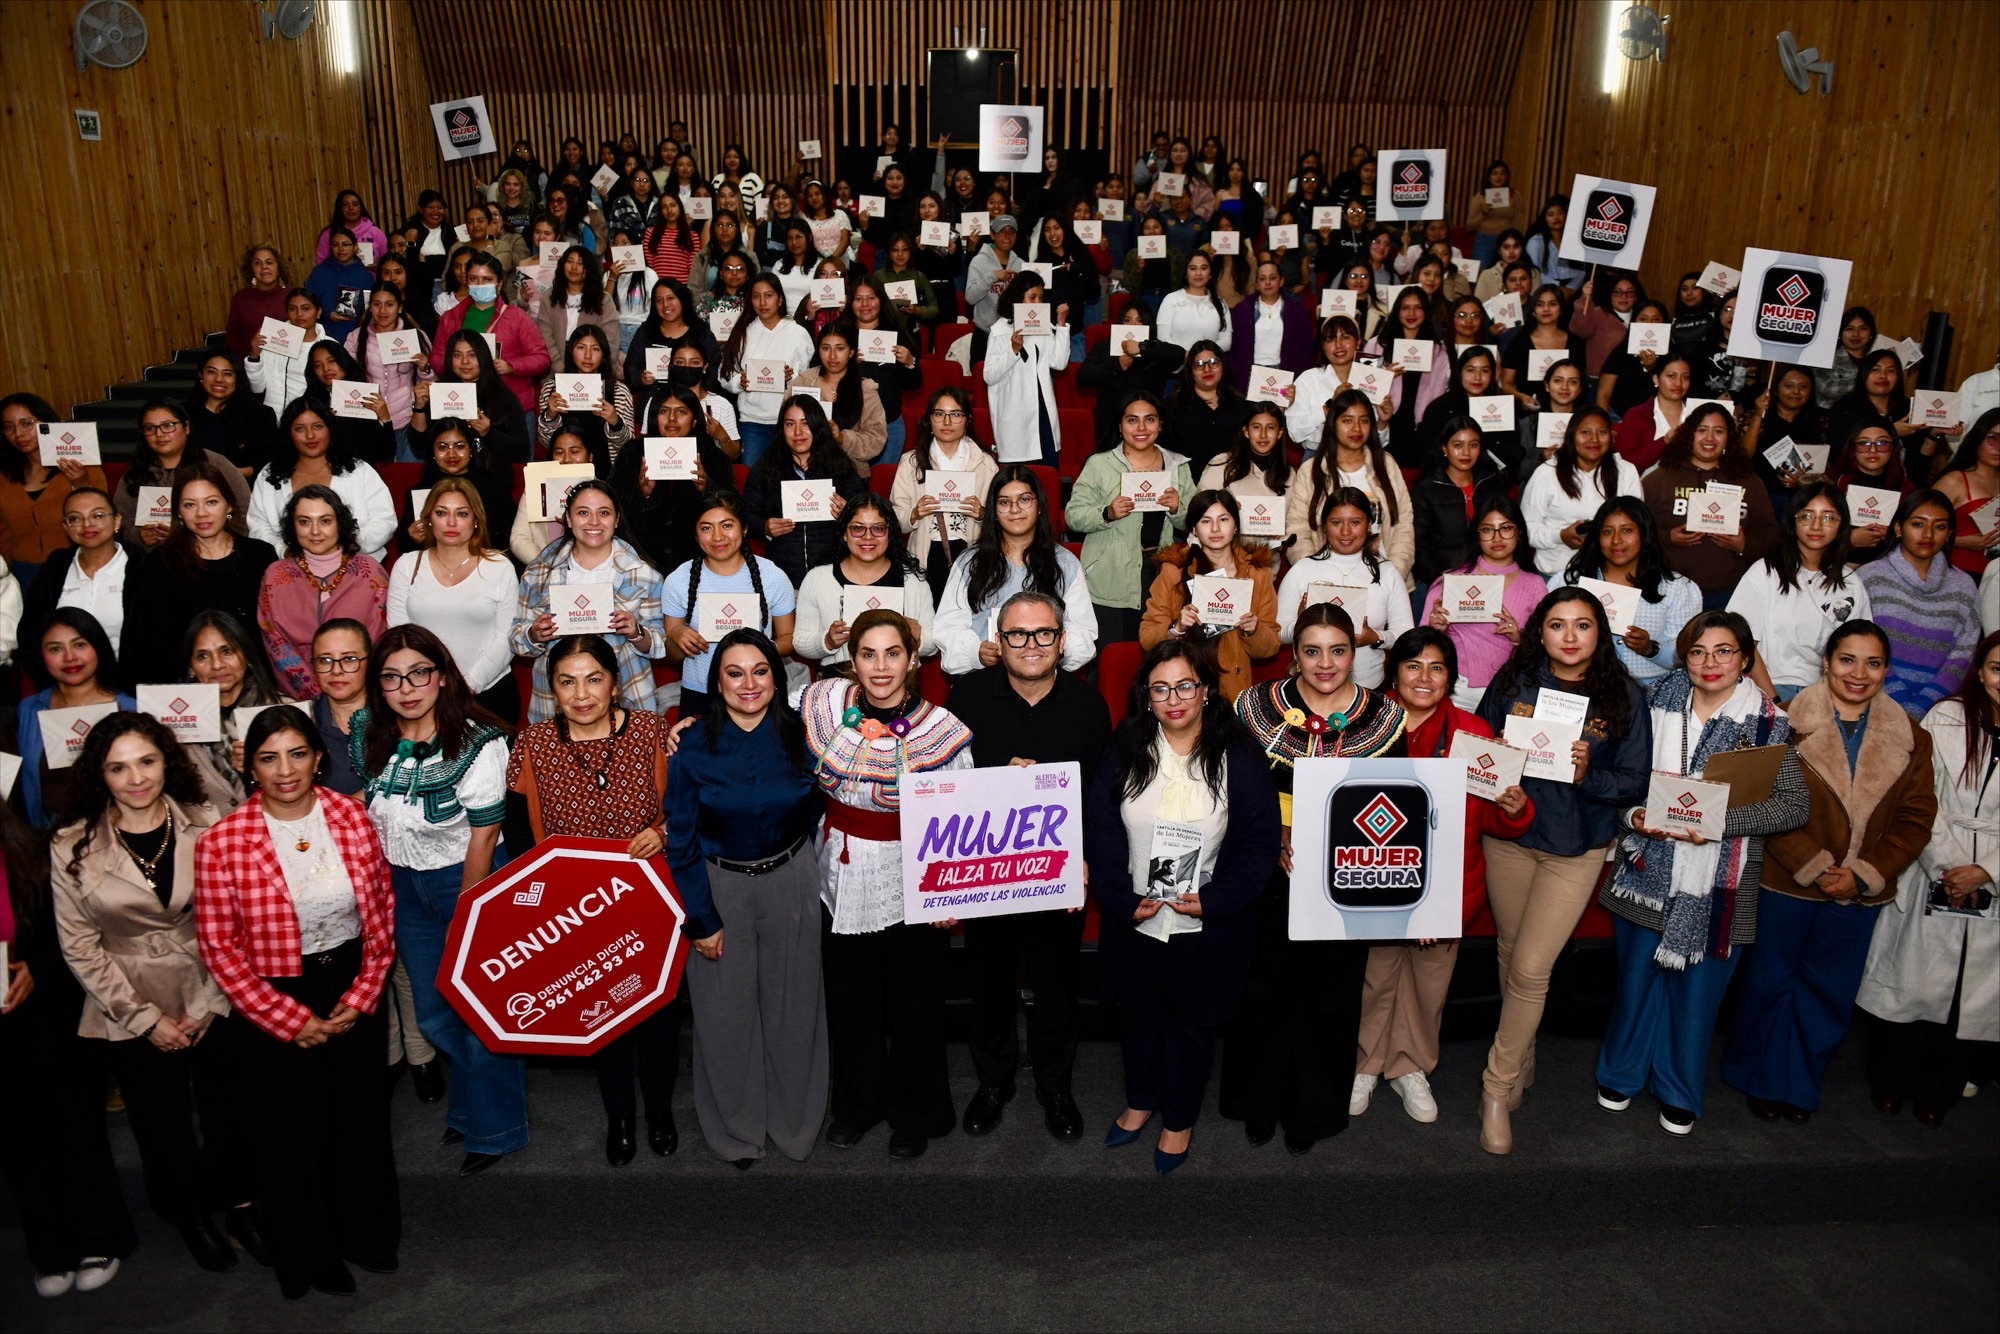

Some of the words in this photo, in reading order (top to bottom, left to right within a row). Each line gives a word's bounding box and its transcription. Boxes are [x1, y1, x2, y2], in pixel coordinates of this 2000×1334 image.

[451, 126, 477, 136] MUJER
[453, 132, 479, 142] SEGURA
[1586, 220, 1626, 234] MUJER
[1584, 230, 1623, 243] SEGURA
[1762, 304, 1815, 322] MUJER
[1761, 318, 1812, 334] SEGURA
[1528, 749, 1555, 760] UJER
[1467, 766, 1498, 781] MUJER
[1667, 813, 1702, 824] SEGURA
[1668, 806, 1703, 818] MUJER
[917, 804, 1068, 862] MUJER
[1176, 832, 1201, 842] Mujeres
[1336, 848, 1420, 867] MUJER
[936, 862, 984, 887] ¡ALZA
[990, 860, 1010, 880] TU
[1015, 856, 1051, 877] VOZ!
[1336, 870, 1420, 886] SEGURA
[923, 892, 990, 909] DETENGAMOS
[990, 889, 1009, 902] LAS
[1012, 884, 1066, 899] VIOLENCIAS
[480, 877, 634, 982] DENUNCIA
[537, 960, 596, 1001] DENUNCIA
[596, 930, 640, 962] DIGITAL
[545, 988, 574, 1010] 961
[576, 968, 604, 992] 462
[602, 956, 624, 973] 93
[625, 940, 646, 958] 40
